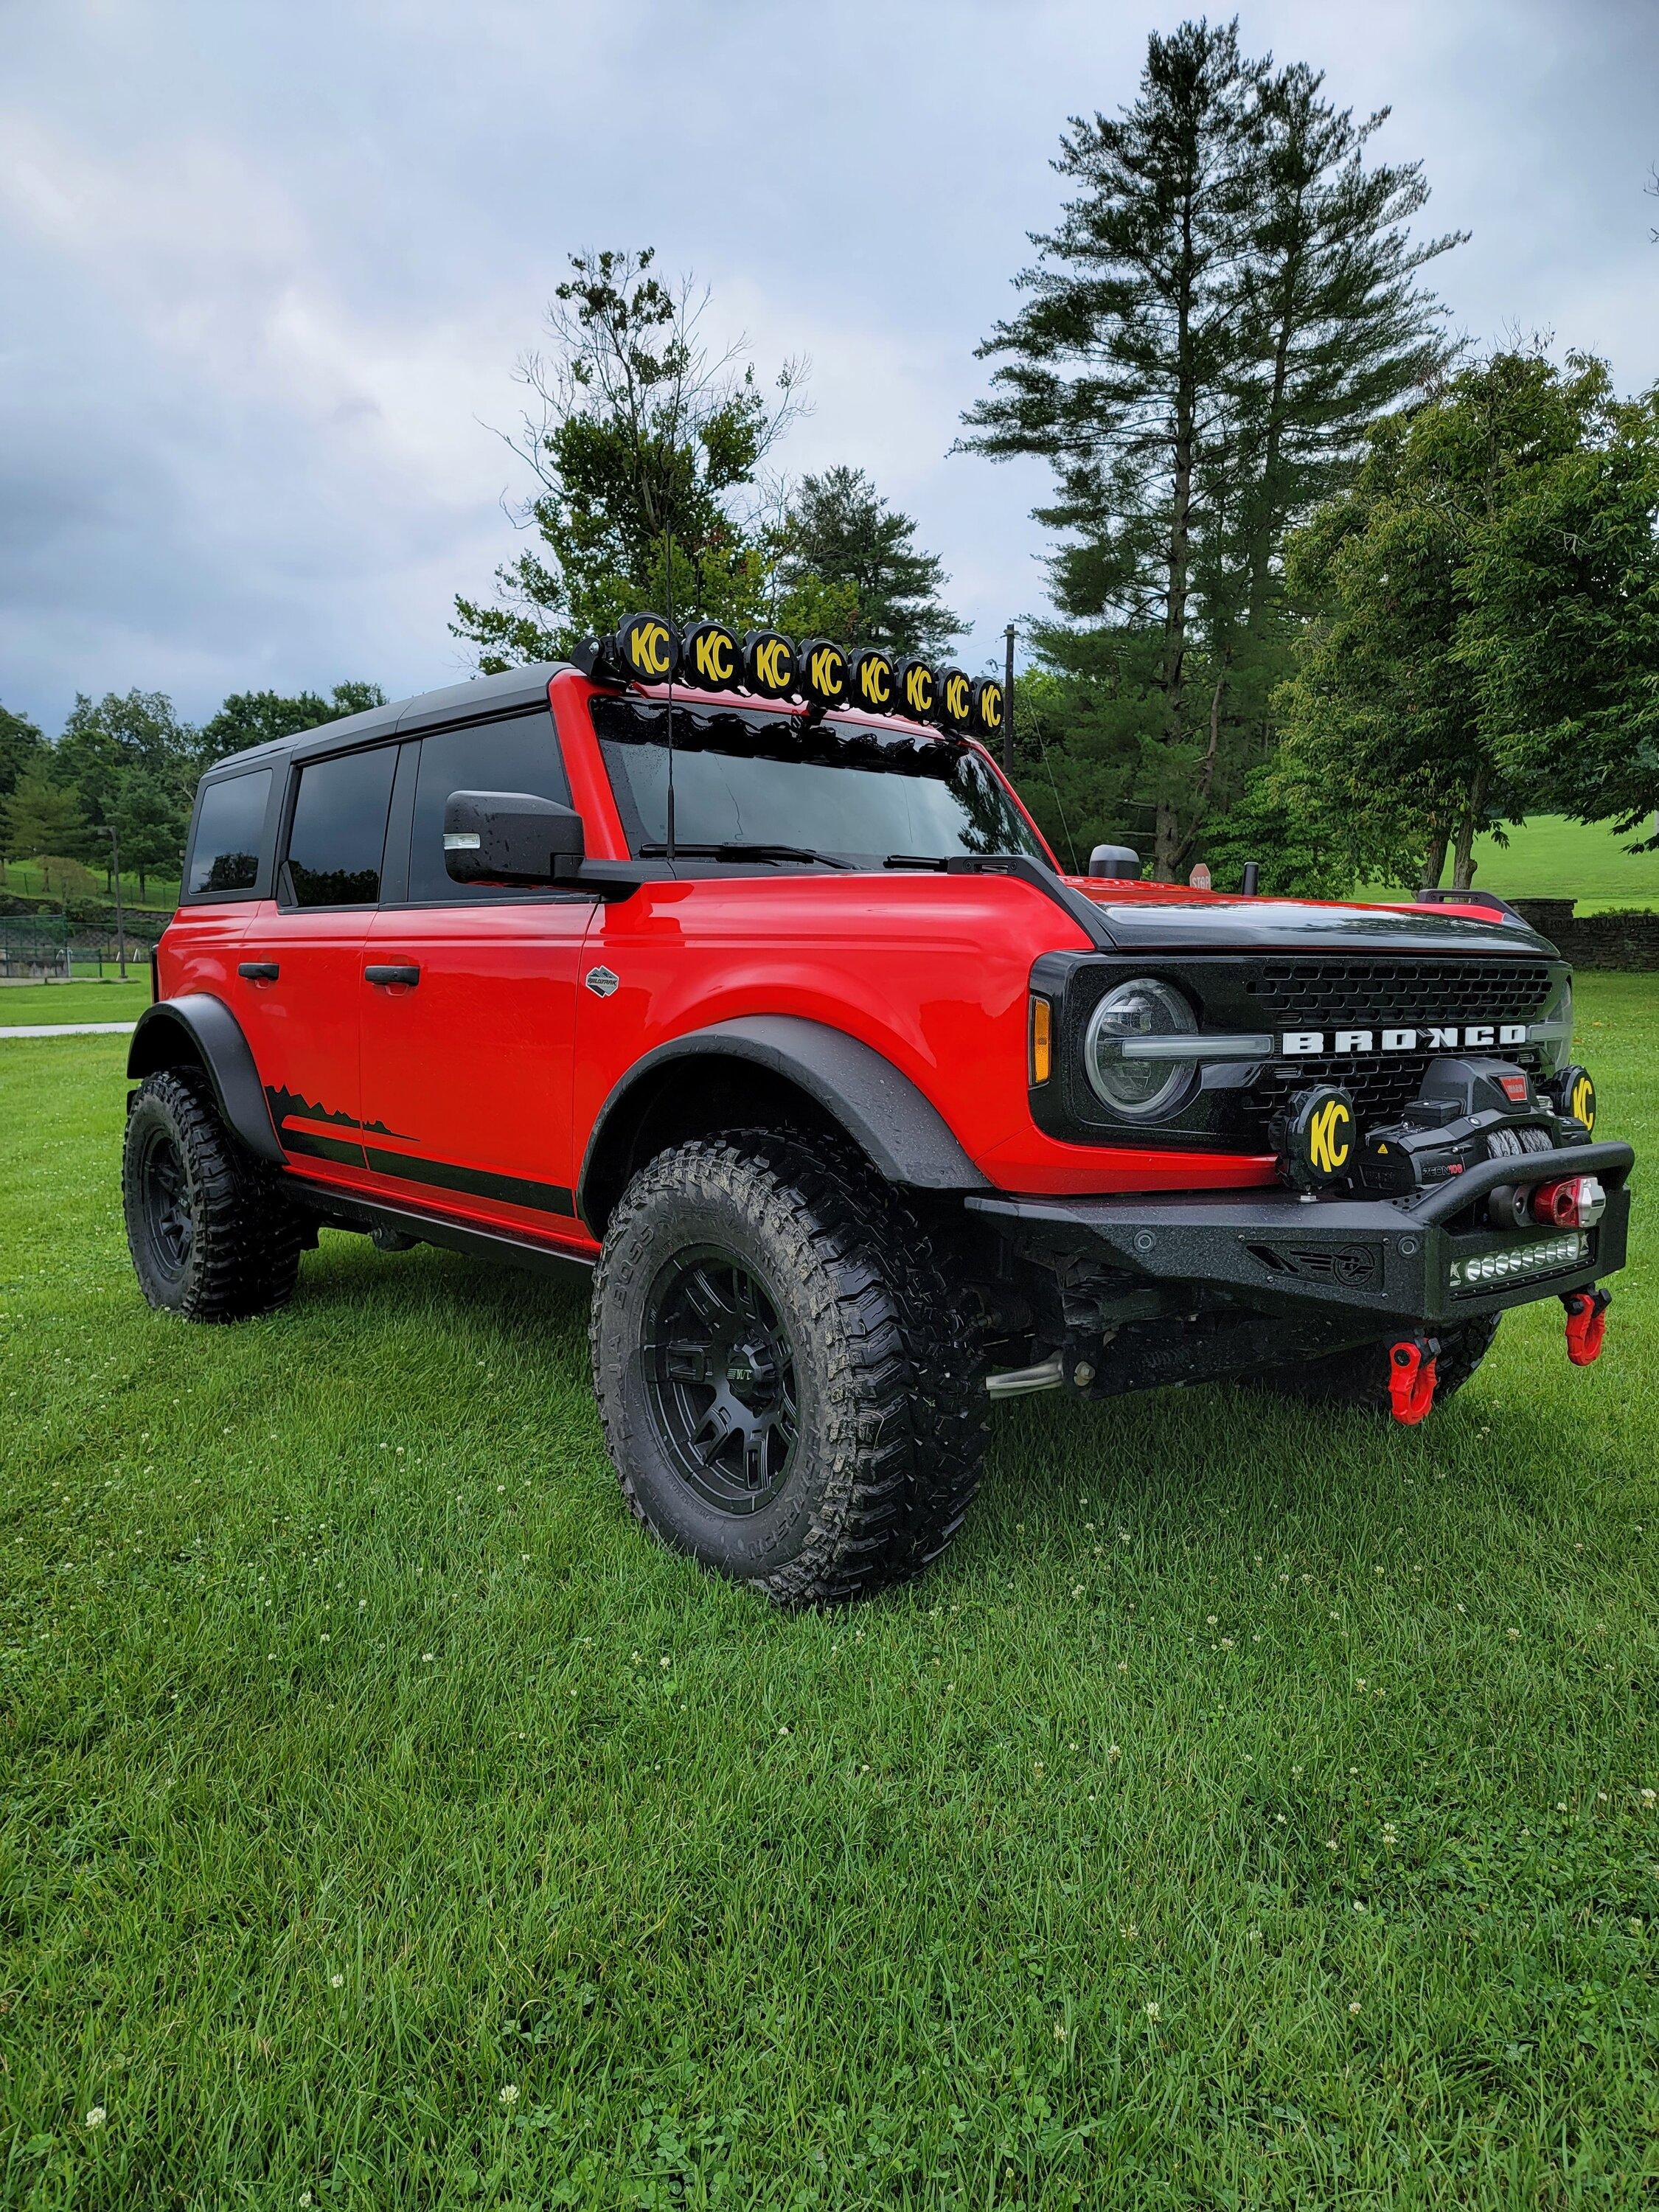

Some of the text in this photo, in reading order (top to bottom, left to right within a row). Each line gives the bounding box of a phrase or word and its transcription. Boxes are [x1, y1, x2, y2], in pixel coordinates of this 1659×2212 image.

[632, 623, 669, 673] KC
[697, 631, 733, 681] KC
[757, 640, 790, 688] KC
[812, 649, 842, 696] KC
[861, 658, 890, 703] KC
[907, 667, 931, 711] KC
[947, 676, 968, 719] KC
[981, 685, 1001, 727] KC
[1192, 876, 1209, 889] STOP
[1283, 1025, 1526, 1055] BRONCO
[1573, 1077, 1593, 1130] KC
[1310, 1100, 1349, 1172] KC
